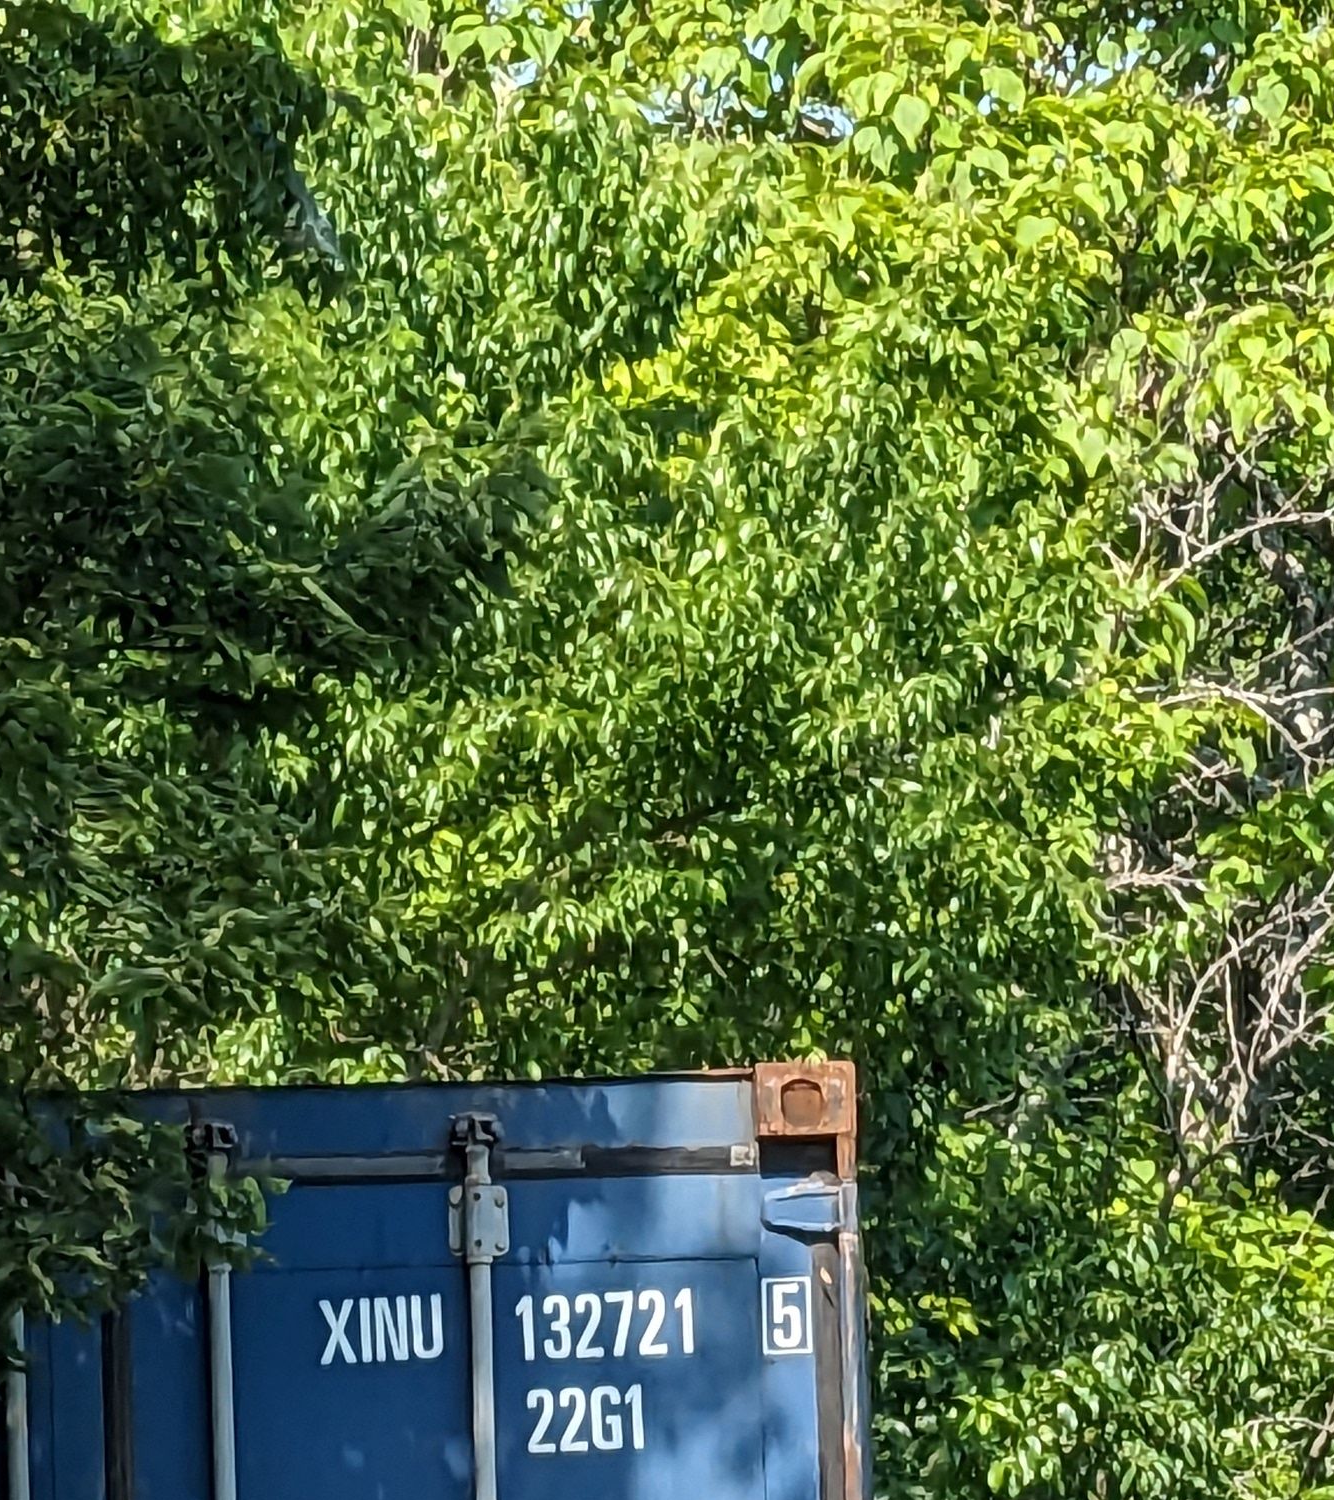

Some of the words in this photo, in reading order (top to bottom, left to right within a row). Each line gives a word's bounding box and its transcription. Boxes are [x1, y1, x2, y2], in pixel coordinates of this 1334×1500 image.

[319, 1294, 444, 1366] XINU
[515, 1287, 695, 1362] 132721
[771, 1281, 803, 1349] 5
[526, 1383, 645, 1454] 22G1
